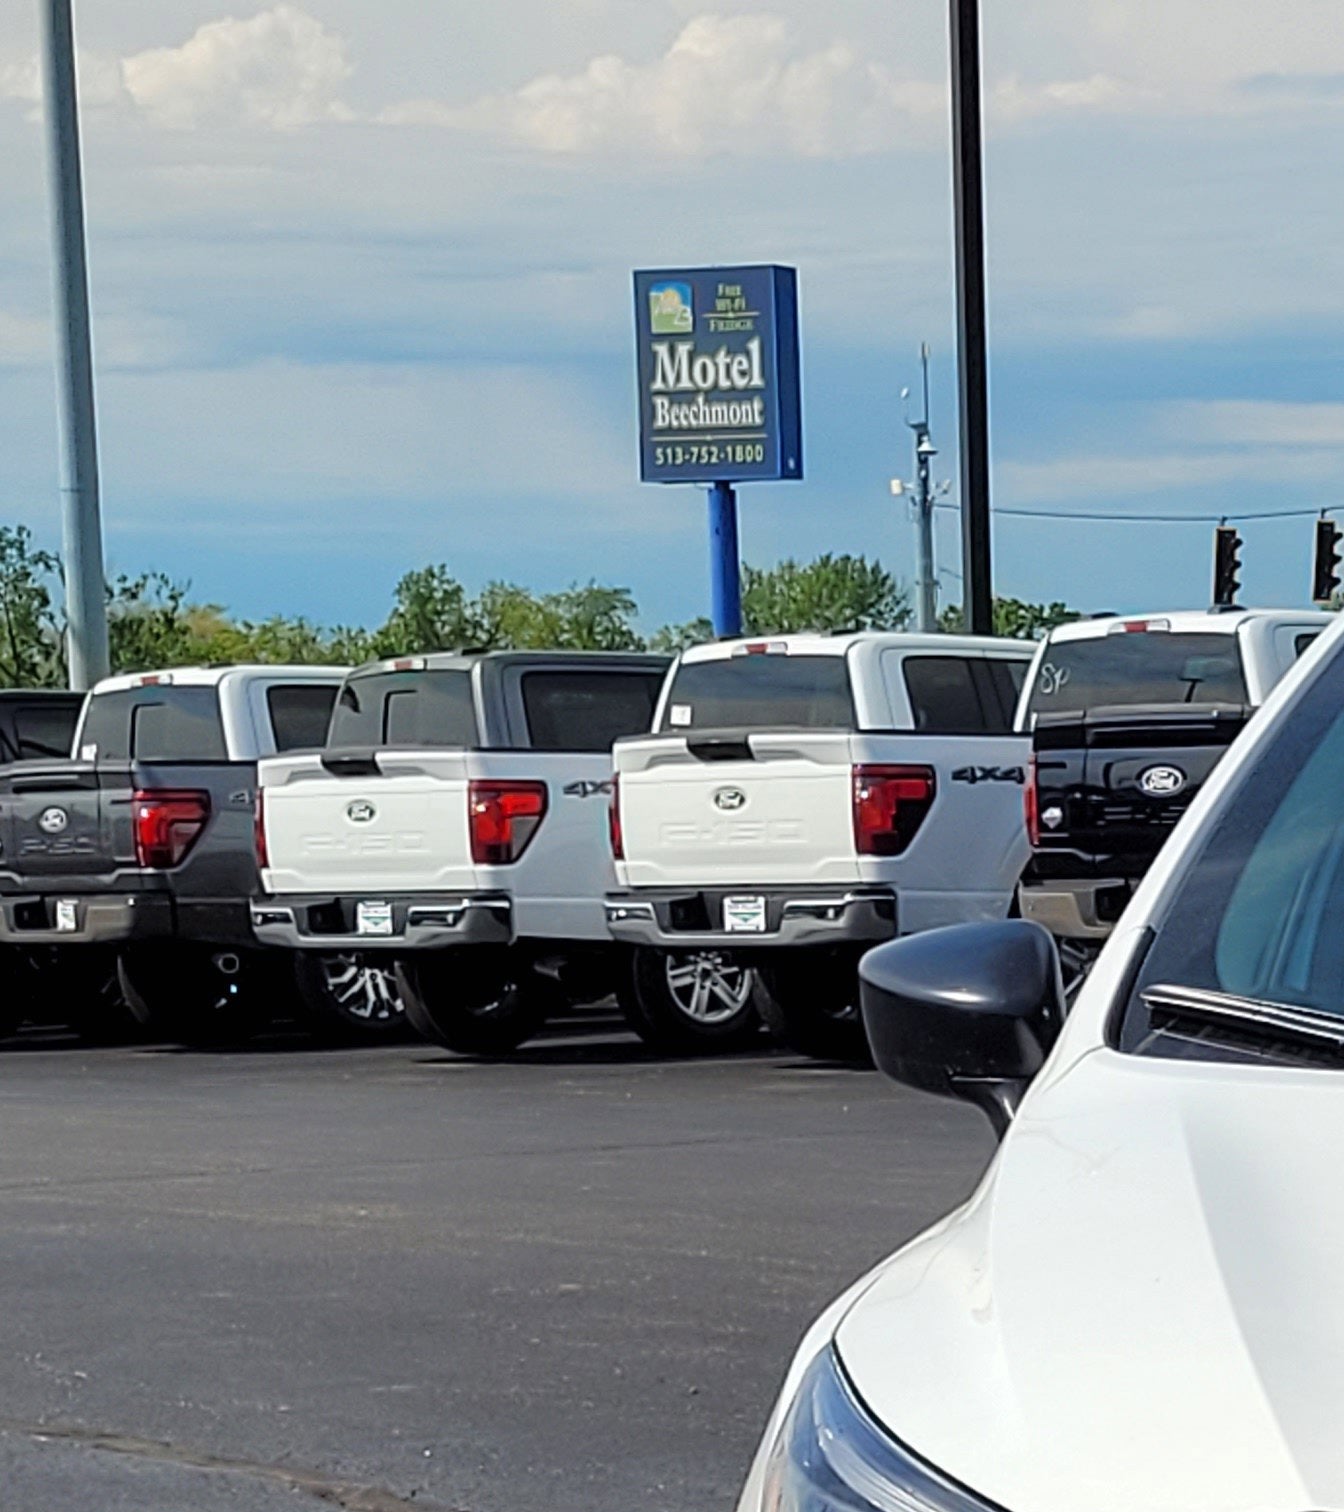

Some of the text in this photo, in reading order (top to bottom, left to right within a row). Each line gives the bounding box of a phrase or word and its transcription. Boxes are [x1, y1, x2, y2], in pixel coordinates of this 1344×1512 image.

[652, 336, 765, 390] Motel
[653, 393, 764, 428] Beechmont
[655, 445, 764, 465] 513-752-1800
